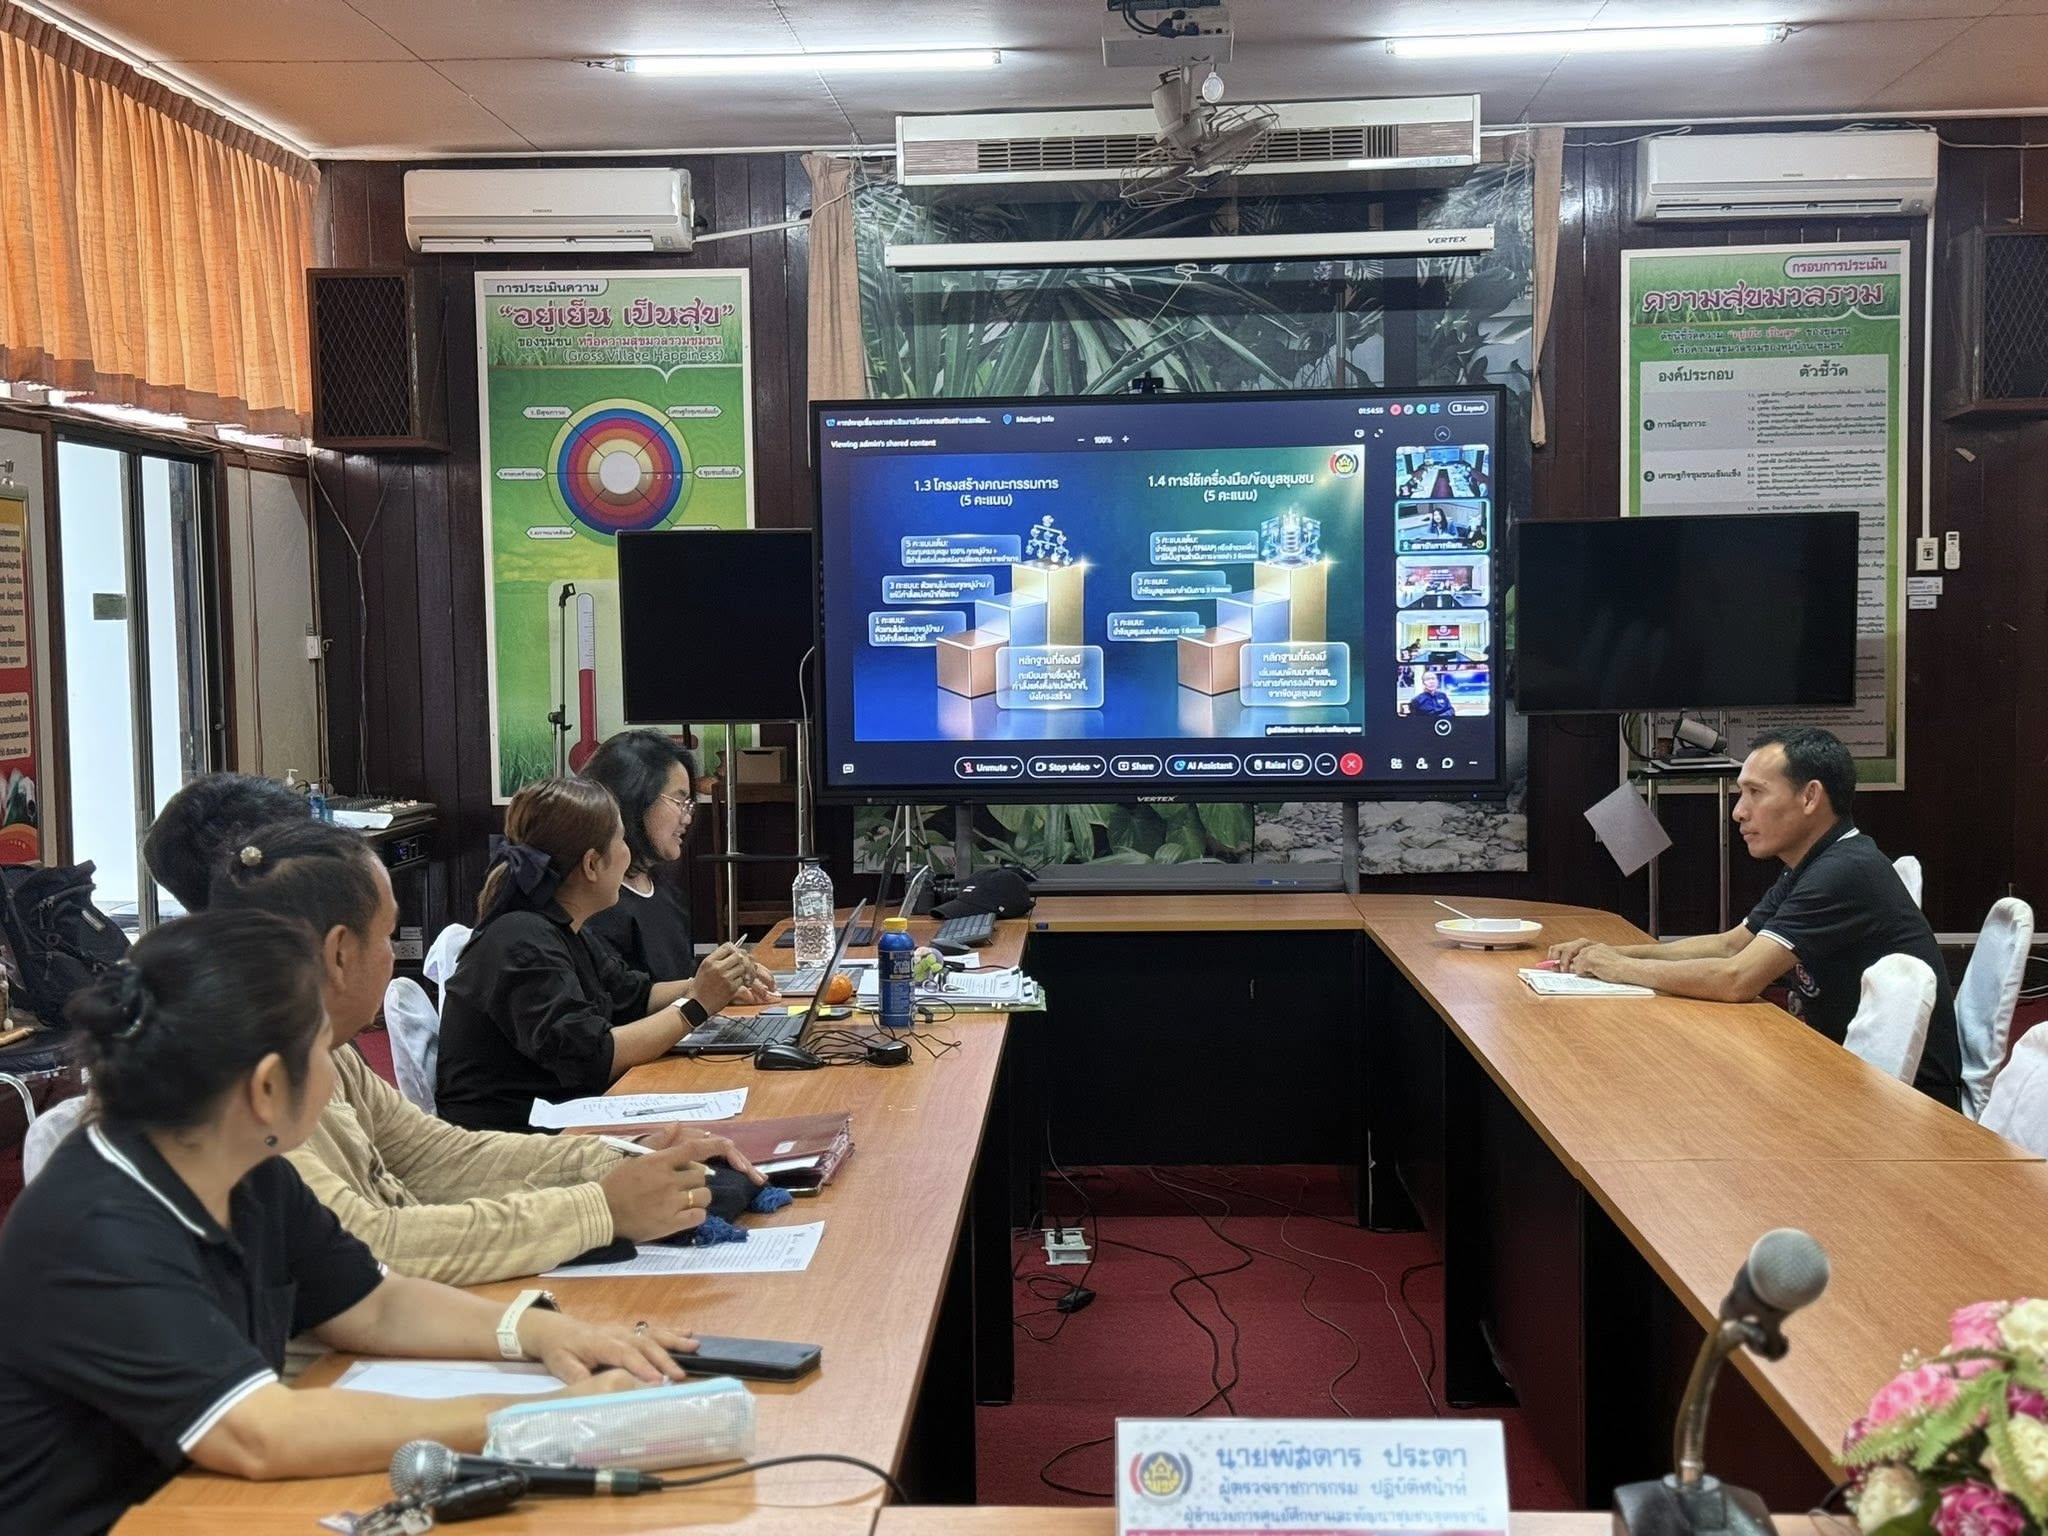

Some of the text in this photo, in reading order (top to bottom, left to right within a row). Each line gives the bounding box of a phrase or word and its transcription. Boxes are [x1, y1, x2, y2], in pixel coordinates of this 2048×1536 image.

[1427, 236, 1467, 244] VERTEX
[1792, 257, 1887, 275] กรอบการประเมิน
[496, 280, 599, 294] การประเมินความ
[1643, 280, 1883, 315] ความสุขมวลรวม
[499, 298, 735, 334] “อยู่เย็น เป็นสุข”
[1805, 327, 1850, 340] ของชุมชน
[517, 334, 722, 351] ของชุมชน หรือความสุขมวลรวมชุมชน
[563, 349, 725, 363] (Gross Village Happiness)
[1658, 360, 1848, 383] องค์ประกอบ ตัวชี้วัด
[1463, 404, 1485, 413] Layout
[1657, 418, 1707, 430] การมีสุขภาวะ
[831, 439, 936, 449] Viewing admin's shared content
[1094, 436, 1113, 444] 100%
[1148, 469, 1314, 491] 1.4 การใช้เครื่องมือ/ข้อมูลชุมชน
[1658, 470, 1741, 482] เศรษฐกิจชุมชนเข้มแข็ง
[914, 477, 1059, 492] 1.3 โครงสร้างคณะกรรมการ
[960, 494, 1013, 507] (5 คะแนน)
[1203, 489, 1258, 503] (5 คะแนน)
[1018, 652, 1081, 666] หลักฐานที่ต้องมี
[1263, 648, 1327, 663] หลักฐานที่ต้องมี
[976, 763, 1008, 773] Unmute
[1048, 763, 1090, 774] Stop video
[1131, 761, 1154, 771] Share
[1187, 760, 1233, 770] AI Assistant
[1265, 760, 1286, 770] Raise
[1216, 1440, 1467, 1470] นายพิสดาร ประดา
[1218, 1472, 1467, 1503] ผู้ตรวจราชการกรม ปฏิบัติหน้าที่
